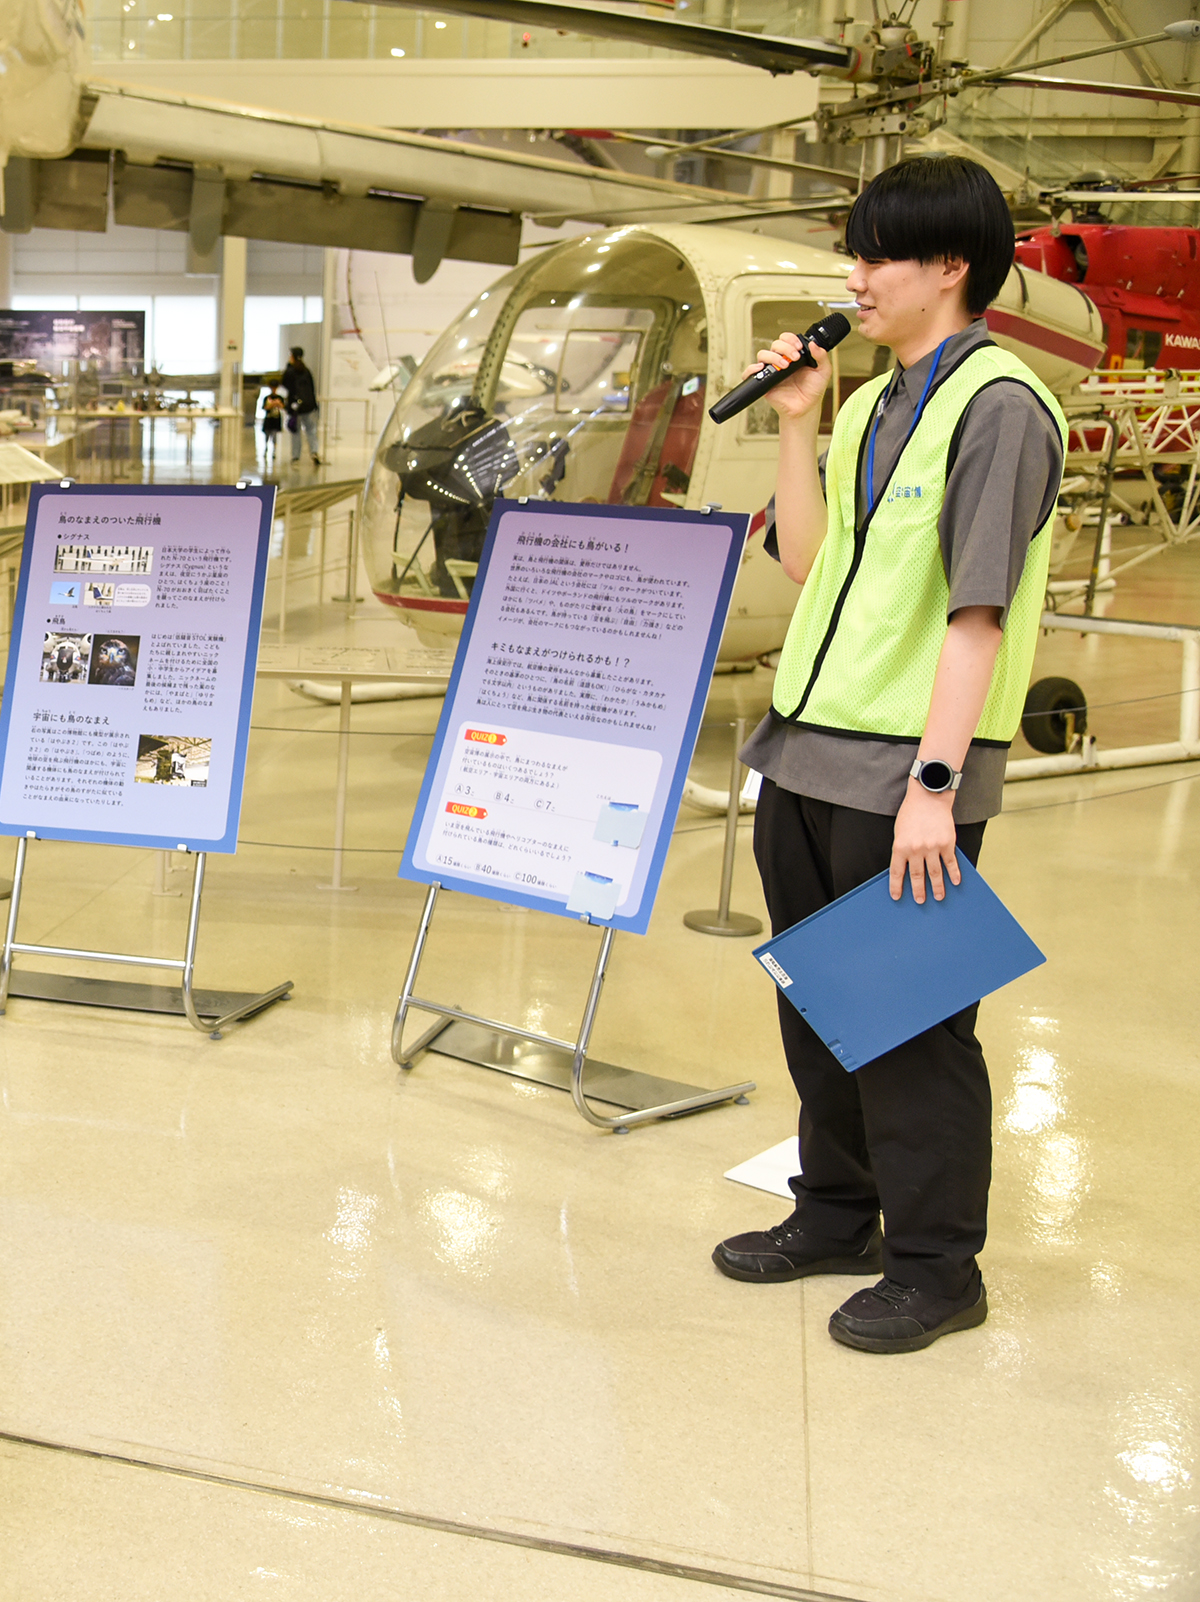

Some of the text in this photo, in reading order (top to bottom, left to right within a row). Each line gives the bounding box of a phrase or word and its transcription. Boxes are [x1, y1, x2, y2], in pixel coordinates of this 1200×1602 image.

[1165, 333, 1200, 350] KAWA
[58, 515, 161, 525] 鳥のなまえのついた飛行機
[63, 533, 90, 541] シグナス
[515, 534, 630, 553] 飛行機の会社にも鳥がいる！
[489, 641, 631, 668] キミもなまえがつけられるかも！？
[33, 712, 110, 725] 宇宙にも鳥のなまえ
